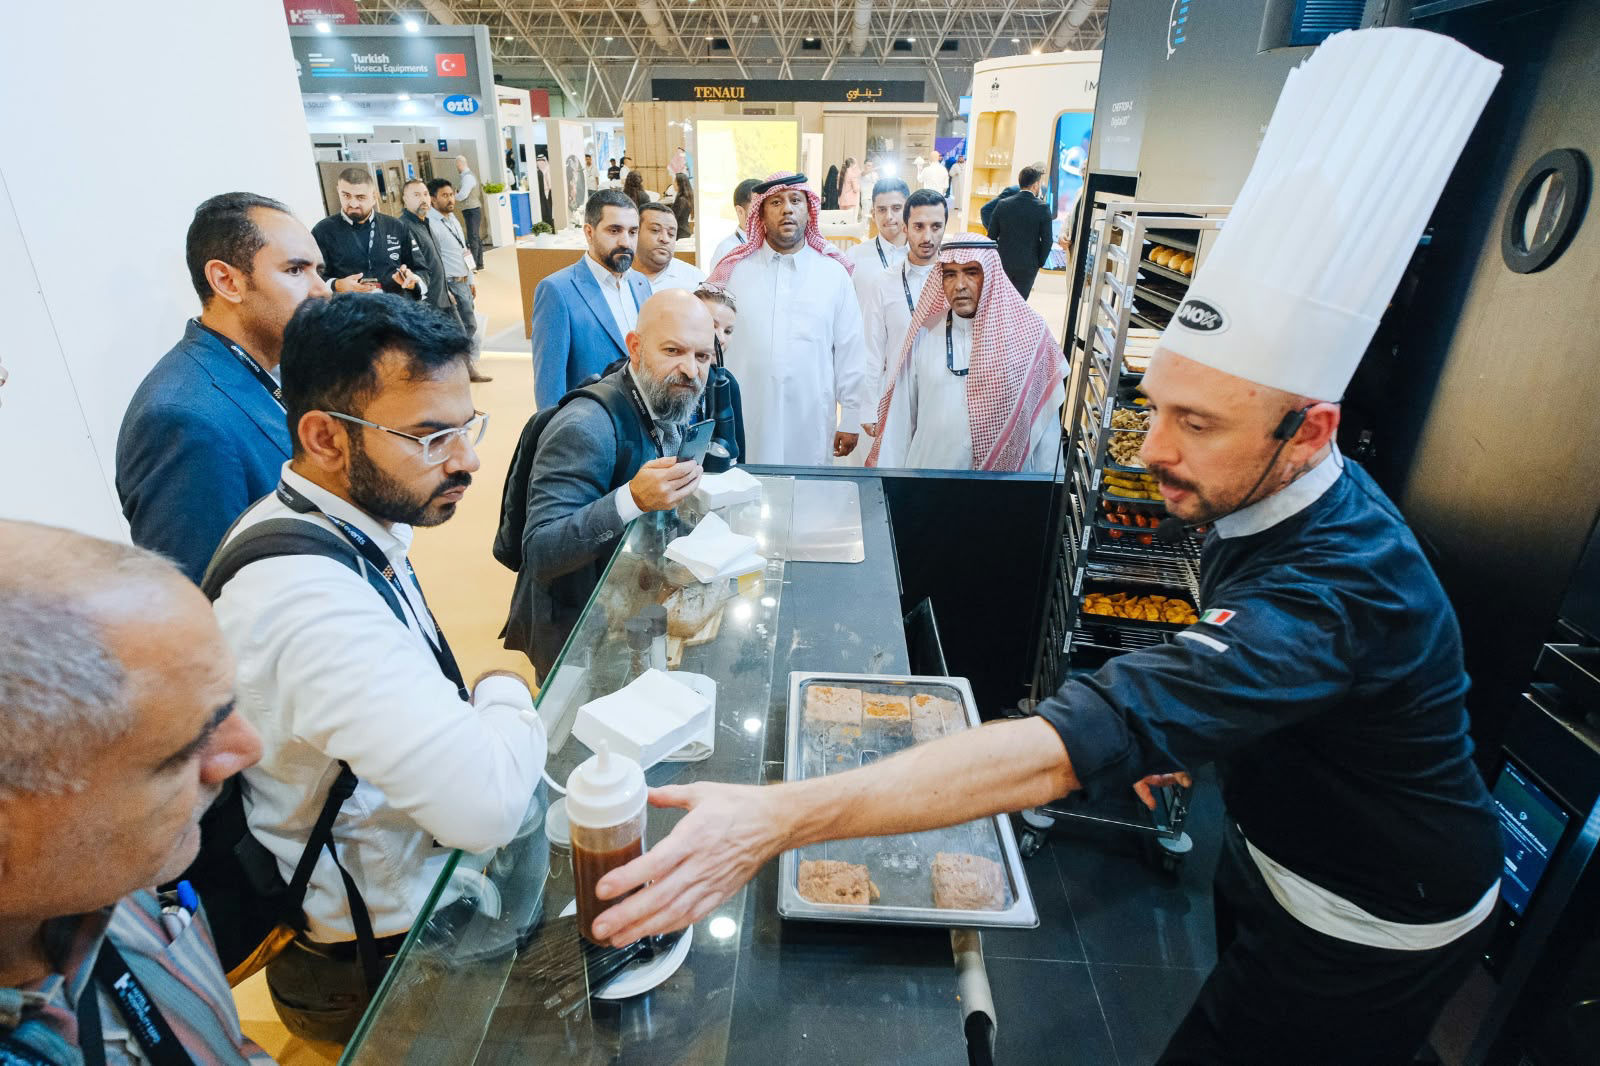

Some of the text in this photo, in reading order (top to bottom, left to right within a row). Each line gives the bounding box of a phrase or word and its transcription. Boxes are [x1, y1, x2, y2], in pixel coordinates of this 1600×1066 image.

[351, 53, 390, 64] Turkish
[354, 64, 429, 74] Horeca Equipments
[694, 86, 745, 99] TENAUI
[343, 525, 366, 546] events
